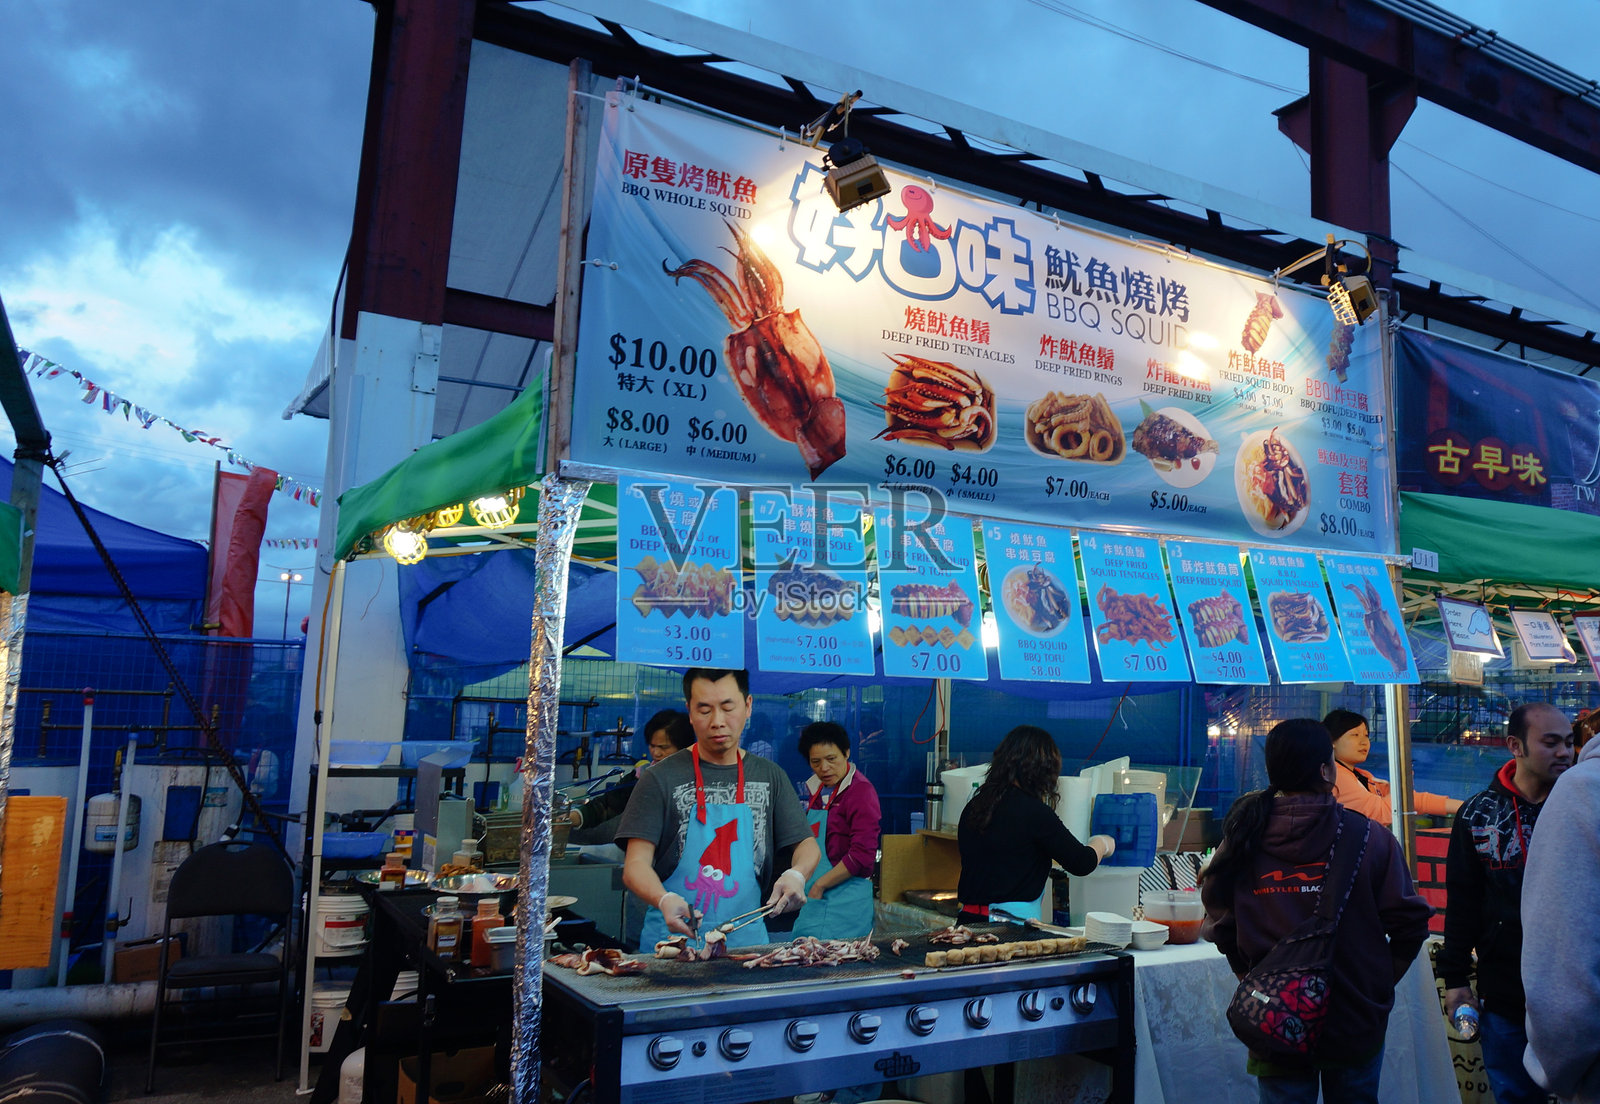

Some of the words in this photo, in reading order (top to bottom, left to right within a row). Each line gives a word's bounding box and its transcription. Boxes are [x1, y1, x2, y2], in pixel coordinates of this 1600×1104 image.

[622, 149, 757, 204] 原隻烤魷魚
[621, 181, 650, 199] BBQ
[653, 190, 706, 210] WHOLE
[709, 202, 752, 220] SQUID
[1044, 244, 1189, 323] 魷魚燒烤
[904, 305, 990, 345] 燒魷魚鬚
[1046, 292, 1102, 332] BBQ
[1111, 308, 1190, 349] SQUID
[882, 329, 912, 344] DEEP
[916, 336, 949, 351] FRIED
[953, 343, 1015, 364] TENTACLES
[1039, 333, 1115, 371] 炸魷魚鬚
[608, 333, 717, 378] $10.00
[1035, 360, 1060, 374] DEEP
[1063, 366, 1092, 380] FRIED
[1094, 373, 1123, 386] RINGS
[1228, 349, 1285, 381] 炸魷魚筒
[617, 372, 654, 394] 特大
[664, 379, 707, 401] (XL)
[1219, 370, 1244, 383] FRIED
[1245, 376, 1271, 390] SQUID
[1272, 383, 1295, 395] BODY
[1143, 382, 1166, 395] DEEP
[1168, 387, 1193, 400] FRIED
[1195, 392, 1212, 404] REX
[1233, 387, 1257, 403] $4.00
[1261, 394, 1284, 408] $7.00
[1300, 398, 1316, 412] BBQ
[1358, 414, 1383, 425] FRIED
[606, 406, 669, 435] $8.00
[688, 417, 747, 445] $6.00
[1322, 416, 1342, 432] $3.00
[1347, 422, 1366, 438] $5.00
[603, 436, 614, 447] 大
[619, 438, 668, 454] (LARGE)
[686, 446, 696, 456] 中
[701, 446, 757, 463] (MEDIUM)
[1428, 439, 1547, 486] 古早味
[884, 453, 936, 479] $6.00
[951, 462, 998, 487] $4.00
[1045, 475, 1110, 501] $7.00/EACH
[1338, 471, 1369, 499] 套餐
[957, 489, 996, 502] (SMALL)
[1150, 489, 1207, 514] $5.00/EACH
[760, 500, 776, 515] #7
[1340, 498, 1371, 514] COMBO
[881, 514, 896, 529] #6
[641, 524, 668, 538] BBQ
[674, 528, 704, 542] TOFU
[708, 535, 720, 543] or
[988, 526, 1002, 541] #5
[630, 538, 661, 551] DEEP
[664, 542, 697, 556] FRIED
[700, 546, 730, 560] TOFU
[767, 534, 793, 545] DEEP
[797, 537, 826, 548] FRIED
[829, 540, 854, 551] SOLE
[1084, 537, 1096, 550] #4
[811, 551, 837, 562] TOFU
[884, 550, 908, 560] DEEP
[912, 552, 937, 563] FRIED
[1171, 545, 1182, 558] #3
[1253, 552, 1265, 564] #2
[1104, 558, 1123, 567] DEEP
[1125, 560, 1148, 570] FRIED
[1091, 567, 1116, 578] SQUID
[1119, 570, 1159, 580] TENTACLES
[1176, 575, 1194, 584] DEEP
[1196, 576, 1217, 586] FRIED
[1217, 578, 1242, 588] SQUID
[1260, 578, 1283, 586] SQUID
[1285, 579, 1320, 588] TENTACLES
[664, 625, 711, 642] $3.00
[797, 635, 838, 650] $7.00
[1018, 639, 1037, 650] BBQ
[1039, 641, 1068, 651] SQUID
[666, 646, 712, 662] $5.00
[800, 653, 842, 667] $5.00
[911, 652, 961, 672] $7.00
[1023, 652, 1040, 663] BBQ
[1043, 653, 1065, 663] TOFU
[1123, 654, 1167, 671] $7.00
[1212, 651, 1242, 664] $4.00
[1301, 652, 1325, 661] $4.00
[1031, 665, 1061, 677] $8.00
[1217, 666, 1246, 678] $7.00
[1304, 662, 1329, 672] $6.00
[1360, 671, 1386, 680] WHOLE
[1388, 671, 1411, 680] SQUID
